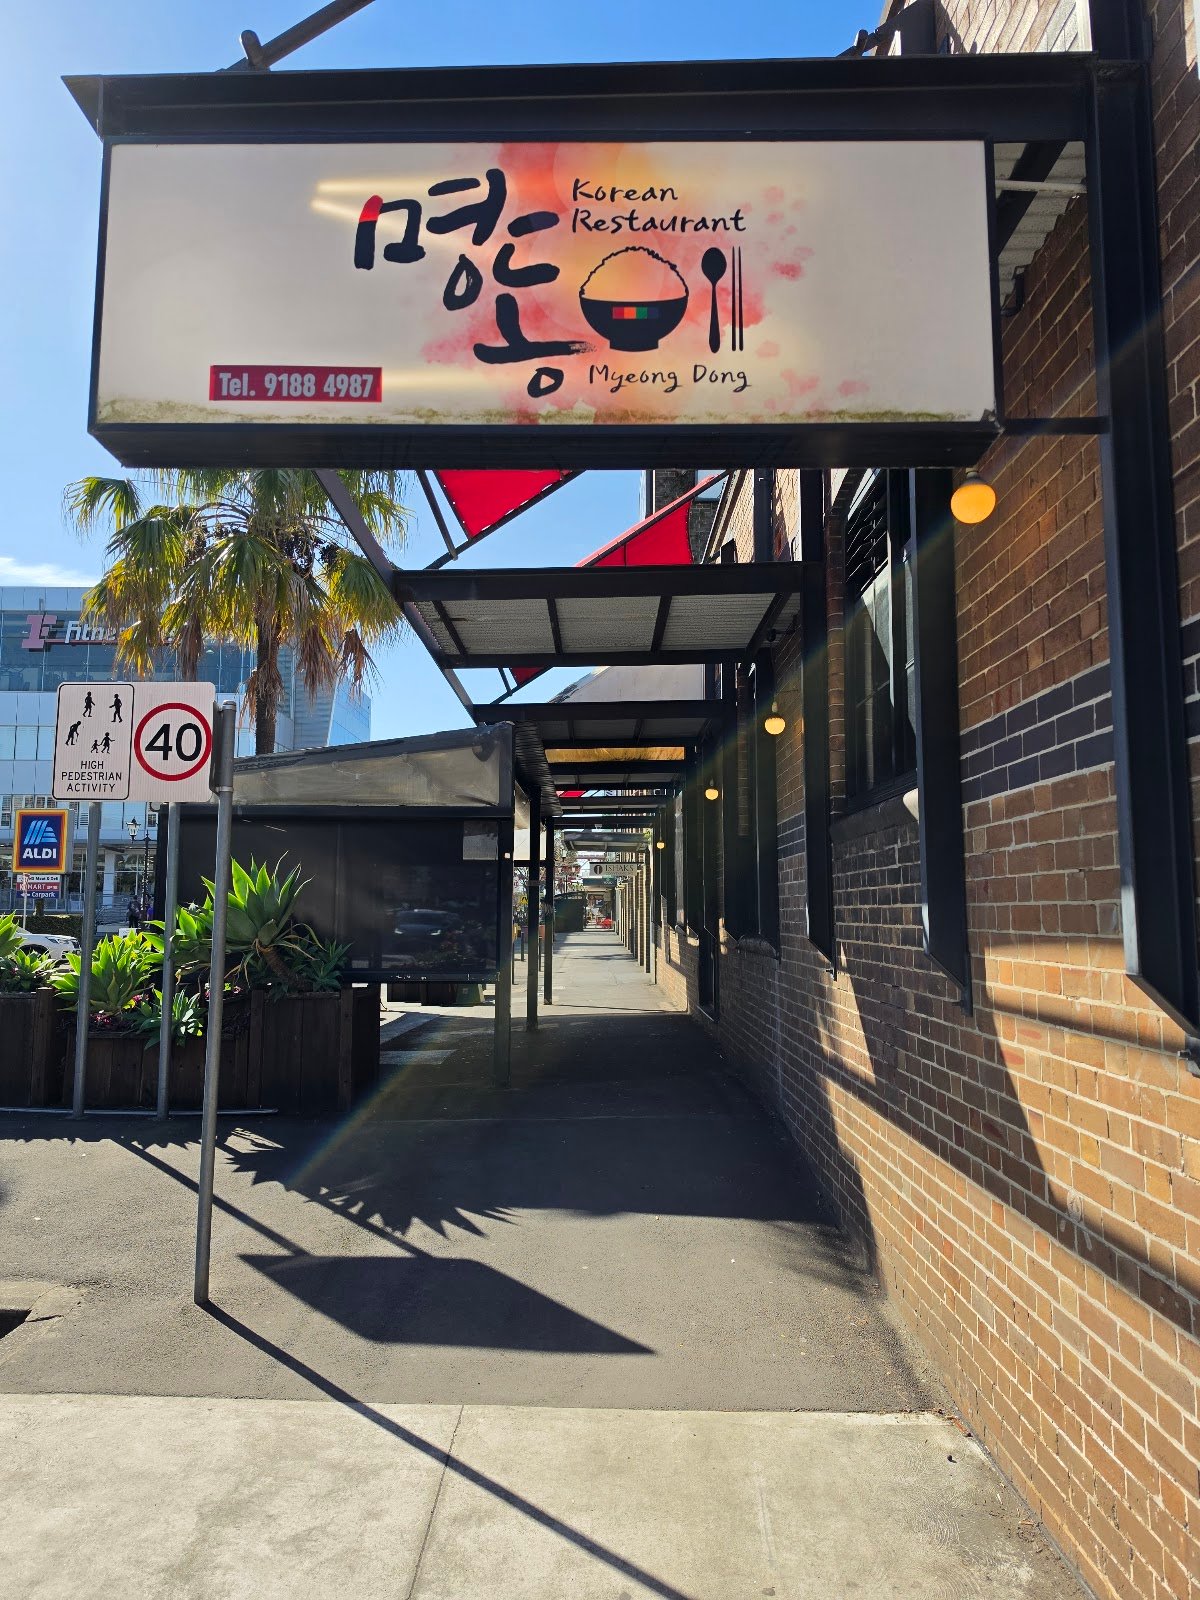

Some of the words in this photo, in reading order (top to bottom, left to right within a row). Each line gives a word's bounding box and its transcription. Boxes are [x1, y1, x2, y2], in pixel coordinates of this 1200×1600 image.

[572, 178, 679, 203] Korean
[572, 208, 747, 234] Restaurant
[219, 372, 256, 397] Tel.
[264, 372, 316, 397] 9188
[323, 373, 374, 398] 4987
[589, 364, 683, 393] Myeong
[693, 364, 752, 393] Dong
[145, 722, 202, 762] 40
[80, 760, 104, 770] HIGH
[61, 771, 122, 781] PEDESTRIAN
[66, 783, 116, 793] ACTIVITY
[22, 847, 57, 859] ALDI
[605, 864, 634, 872] ISHAKS
